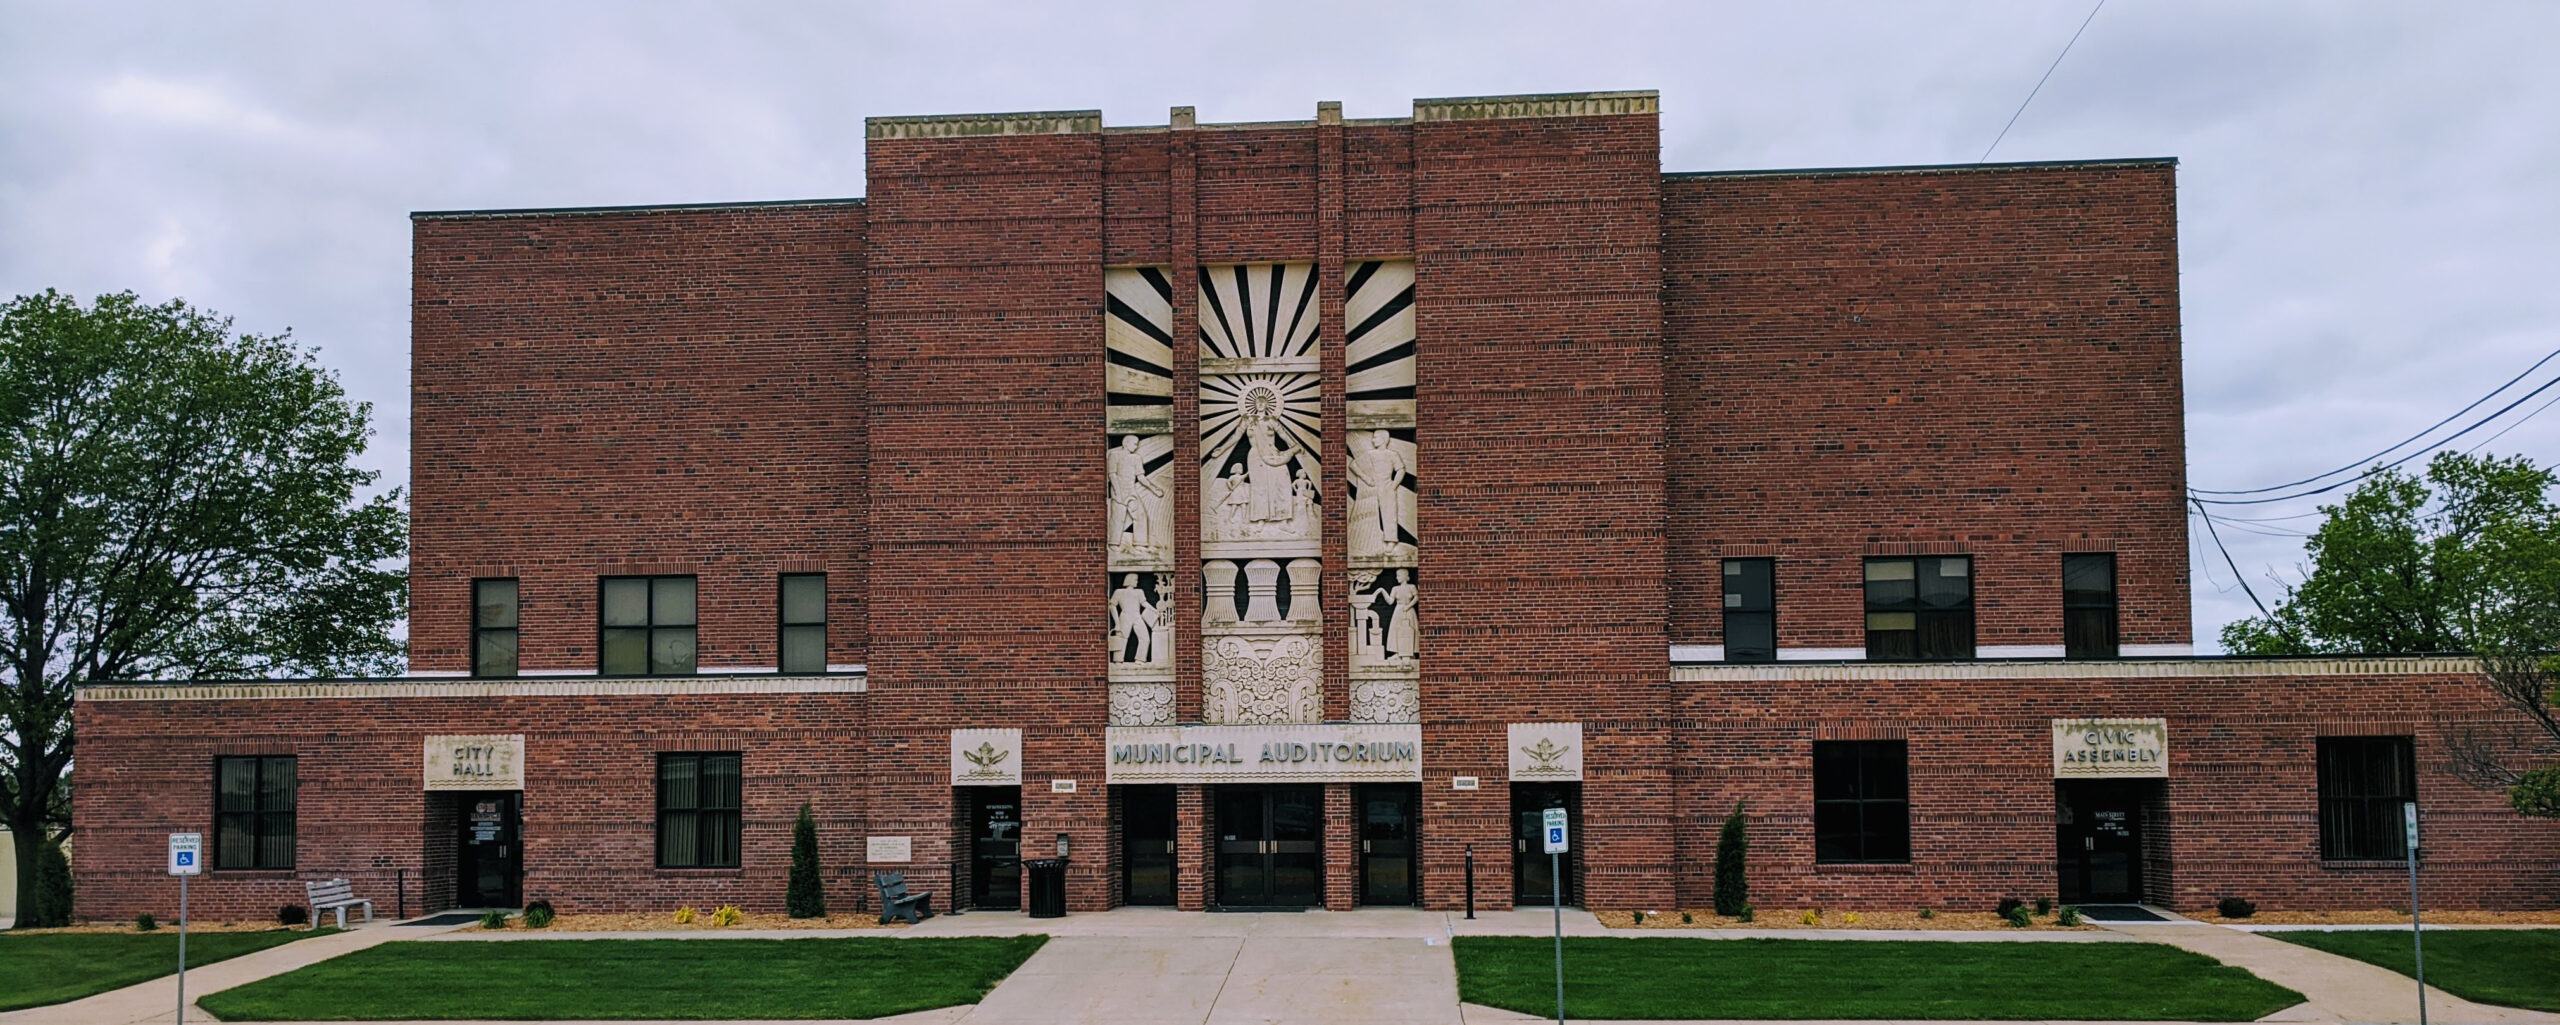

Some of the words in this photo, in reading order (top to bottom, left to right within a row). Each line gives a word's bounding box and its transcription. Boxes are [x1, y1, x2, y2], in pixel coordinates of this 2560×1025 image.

[2085, 731, 2135, 745] CIVIC
[454, 744, 494, 760] CITY
[1113, 743, 1243, 764] MUNICIPAL
[1259, 741, 1415, 763] AUDITORIUM
[2064, 748, 2162, 762] ASSEMBLY
[453, 763, 494, 776] HALL
